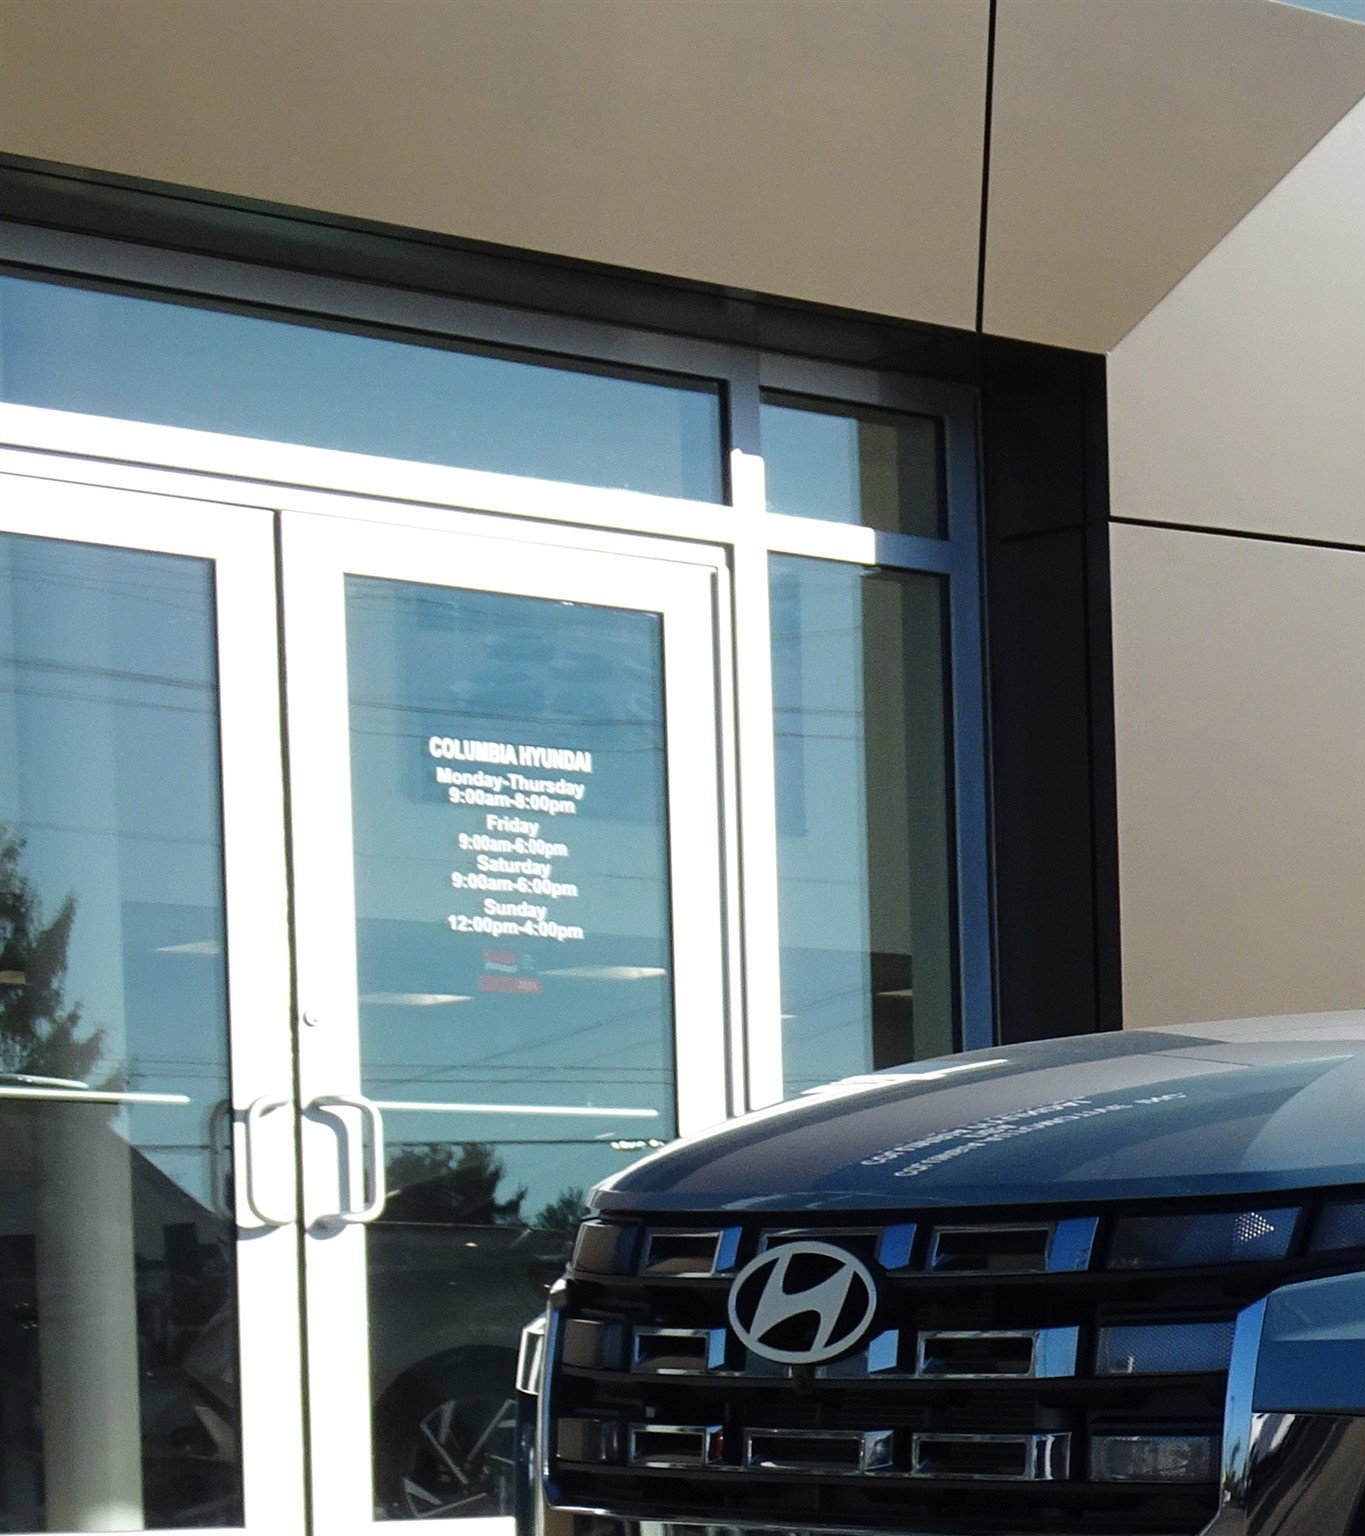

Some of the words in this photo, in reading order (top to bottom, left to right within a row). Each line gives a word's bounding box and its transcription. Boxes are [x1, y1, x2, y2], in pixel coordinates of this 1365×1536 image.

[429, 736, 518, 765] COLUMBIA
[518, 745, 592, 773] HYUNDAI
[436, 767, 586, 800] Monday-Thursday
[486, 814, 540, 837] Friday
[476, 854, 552, 880] Saturday
[483, 898, 547, 921] Sunday
